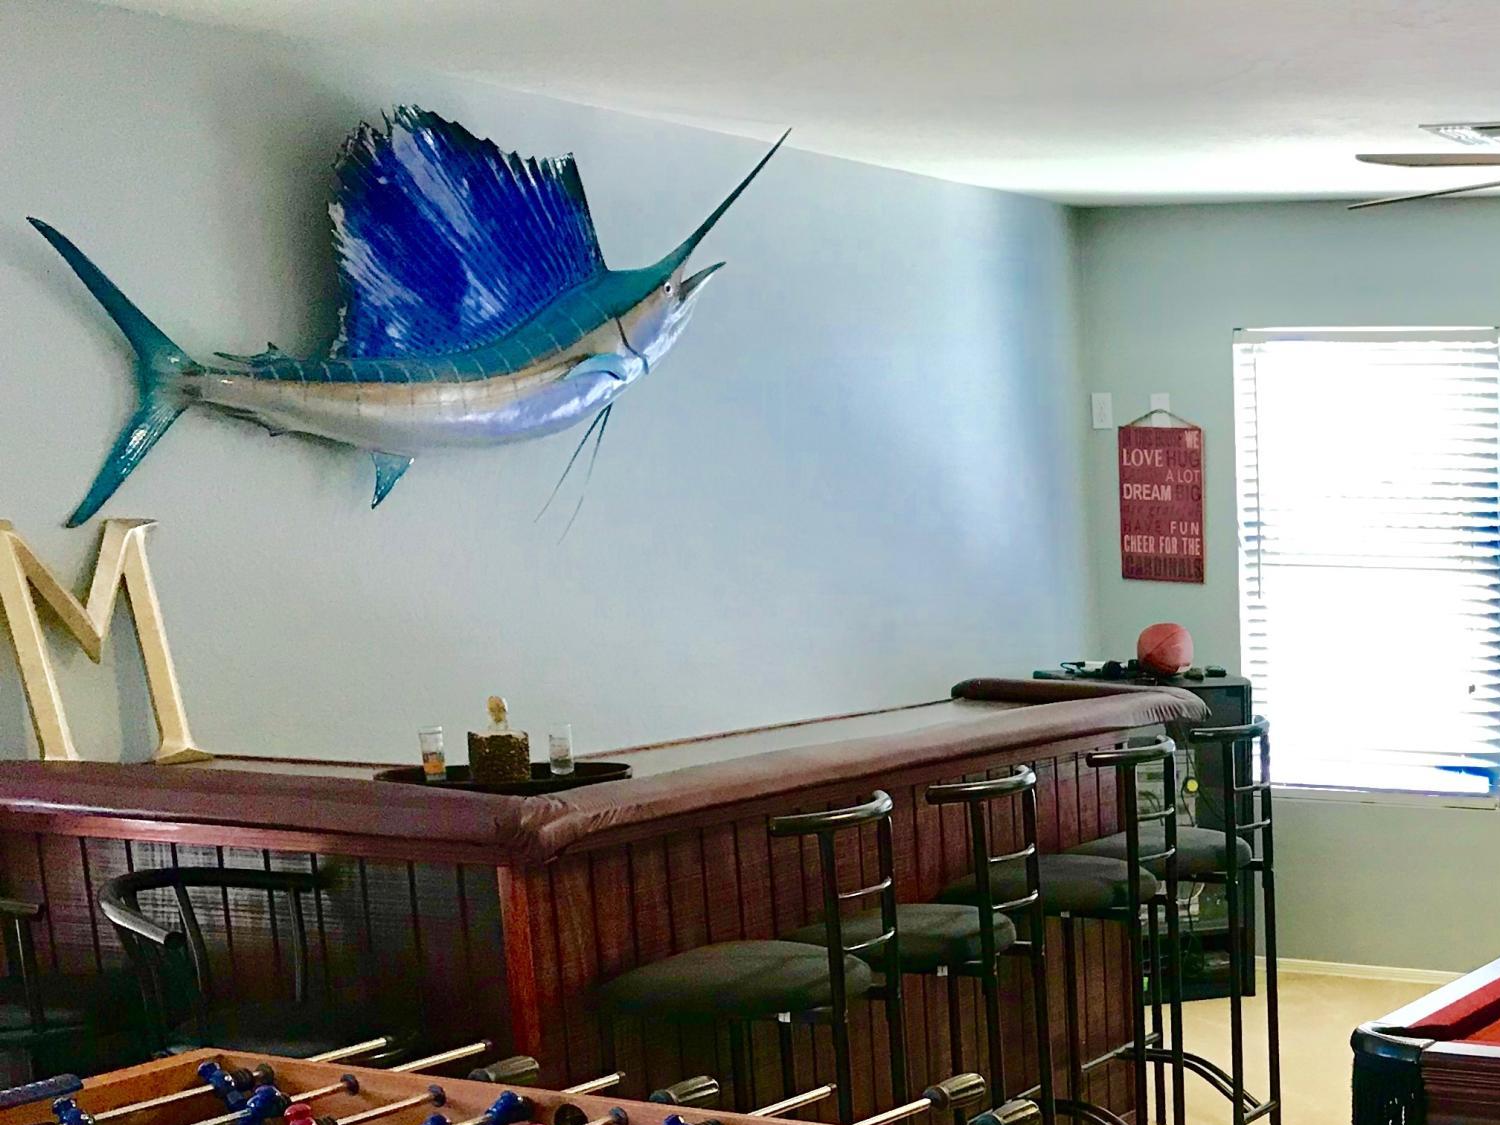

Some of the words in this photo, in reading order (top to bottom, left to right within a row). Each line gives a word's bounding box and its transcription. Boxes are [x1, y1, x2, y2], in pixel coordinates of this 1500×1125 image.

[1184, 430, 1200, 449] WE
[1122, 448, 1163, 467] LOVE
[1166, 450, 1200, 468] HUG
[1165, 469, 1175, 482] A
[1177, 469, 1200, 484] LOT
[1122, 483, 1172, 501] DREAM
[1175, 485, 1201, 501] BIG
[1170, 520, 1200, 536] FUN
[1123, 533, 1156, 553] CHEER
[1158, 535, 1178, 555] FOR
[1181, 537, 1200, 556] THE
[0, 519, 213, 765] M
